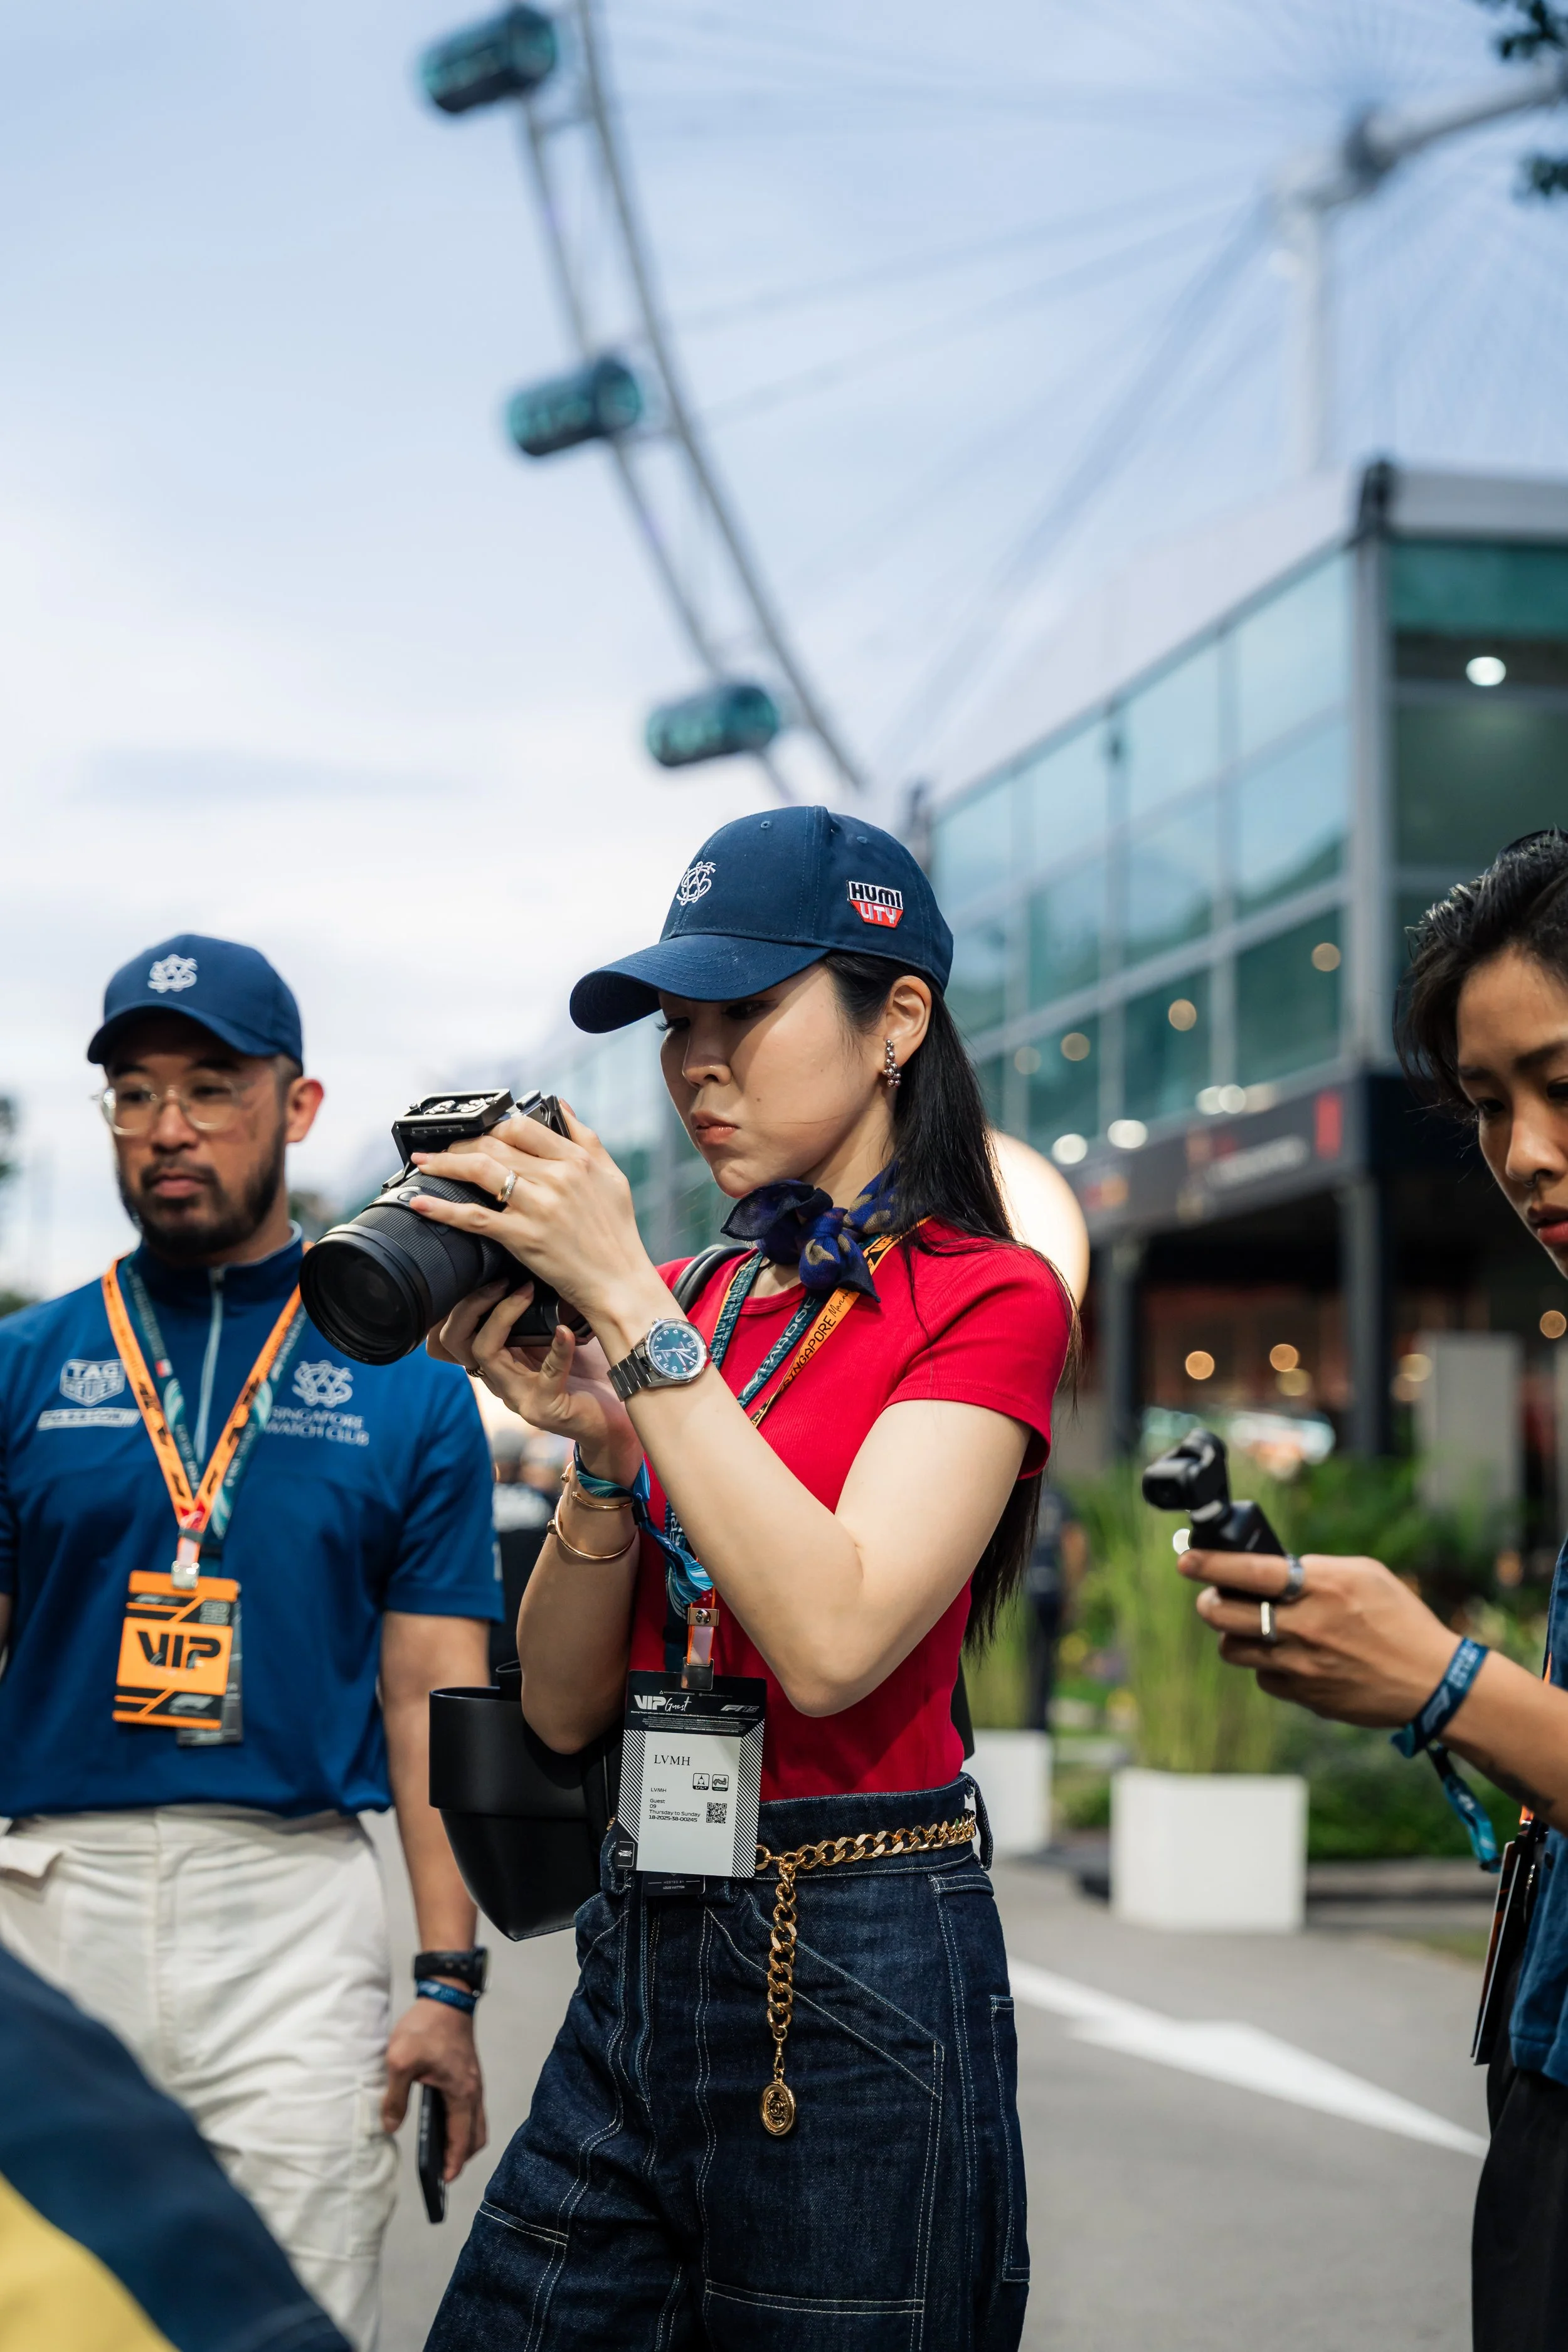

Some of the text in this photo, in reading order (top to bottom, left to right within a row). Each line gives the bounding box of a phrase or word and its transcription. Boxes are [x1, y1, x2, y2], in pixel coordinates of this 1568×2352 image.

[850, 882, 903, 908] HUMI
[860, 902, 897, 924] LITY
[760, 1296, 815, 1372] PADDOC
[135, 1631, 221, 1670] VIP
[634, 1695, 692, 1712] VIP Guest
[654, 1754, 691, 1766] LVMH
